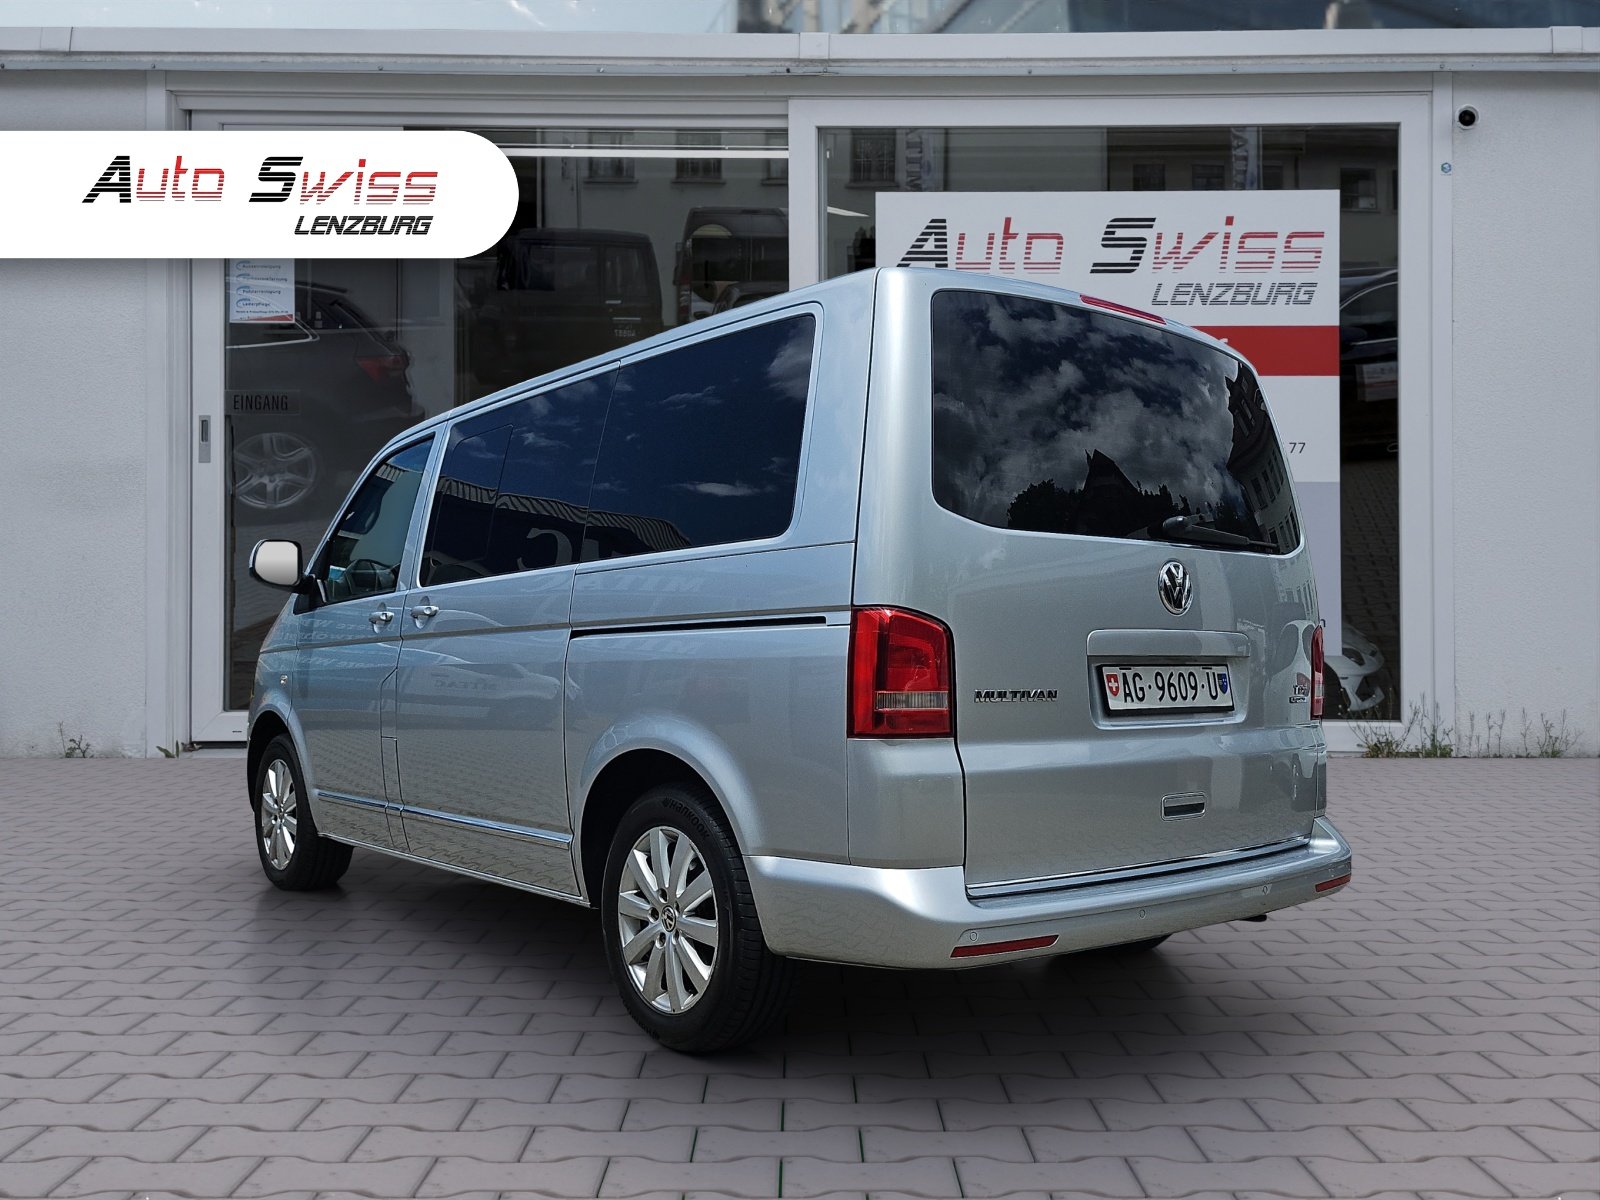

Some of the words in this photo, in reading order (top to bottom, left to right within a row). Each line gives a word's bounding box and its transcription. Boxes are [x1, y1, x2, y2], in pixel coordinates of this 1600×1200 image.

[897, 217, 1064, 274] Auto
[1090, 215, 1325, 273] Swiss
[1151, 282, 1318, 306] LENZBURG
[233, 394, 289, 411] EINGANG
[1288, 442, 1306, 454] 77
[974, 688, 1058, 703] MULTIVAN
